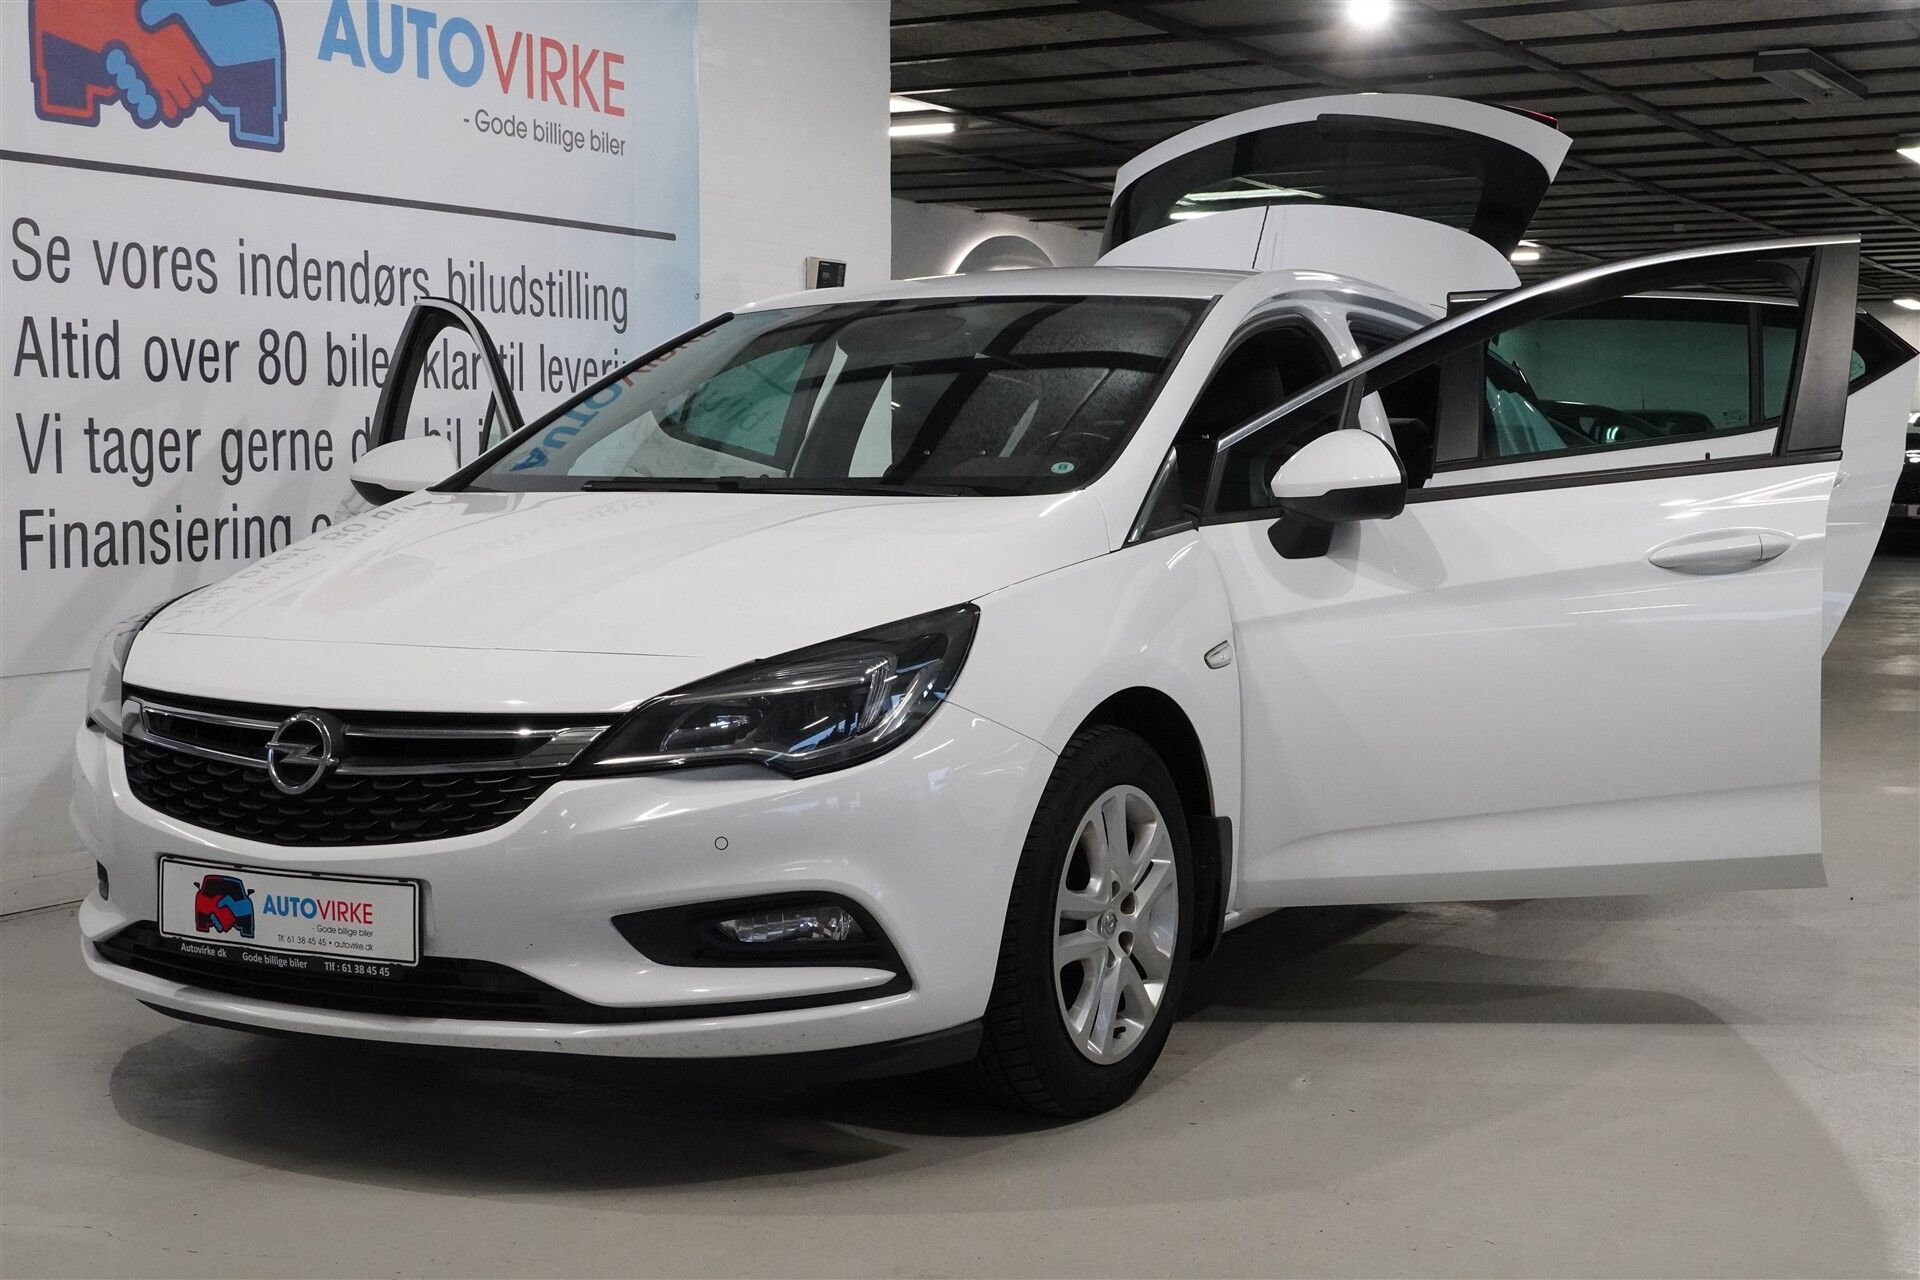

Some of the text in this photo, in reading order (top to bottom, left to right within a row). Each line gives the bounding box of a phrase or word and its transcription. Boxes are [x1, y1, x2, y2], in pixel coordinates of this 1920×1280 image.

[317, 0, 625, 117] AUTOVIRKE
[475, 108, 528, 140] Gode
[533, 119, 585, 153] billige
[590, 132, 626, 156] biler
[12, 217, 629, 335] Se vores indendørs biludstilling
[13, 315, 121, 381] Altid
[144, 335, 240, 383] over
[258, 328, 307, 386] 80
[423, 337, 482, 390] klar
[15, 412, 62, 474] Vi
[83, 417, 201, 487] tager
[220, 428, 333, 486] gerne
[262, 894, 374, 924] AUTOVIRKE
[316, 924, 337, 934] Gode
[242, 952, 263, 963] Gode
[263, 954, 288, 968] billige
[289, 957, 308, 969] biler
[341, 963, 352, 973] 61
[354, 964, 365, 975] 38
[366, 965, 378, 976] 45
[379, 967, 390, 977] 45
[287, 935, 295, 944] 61
[297, 936, 306, 945] 38
[307, 937, 317, 946] 45
[318, 938, 327, 946] 45
